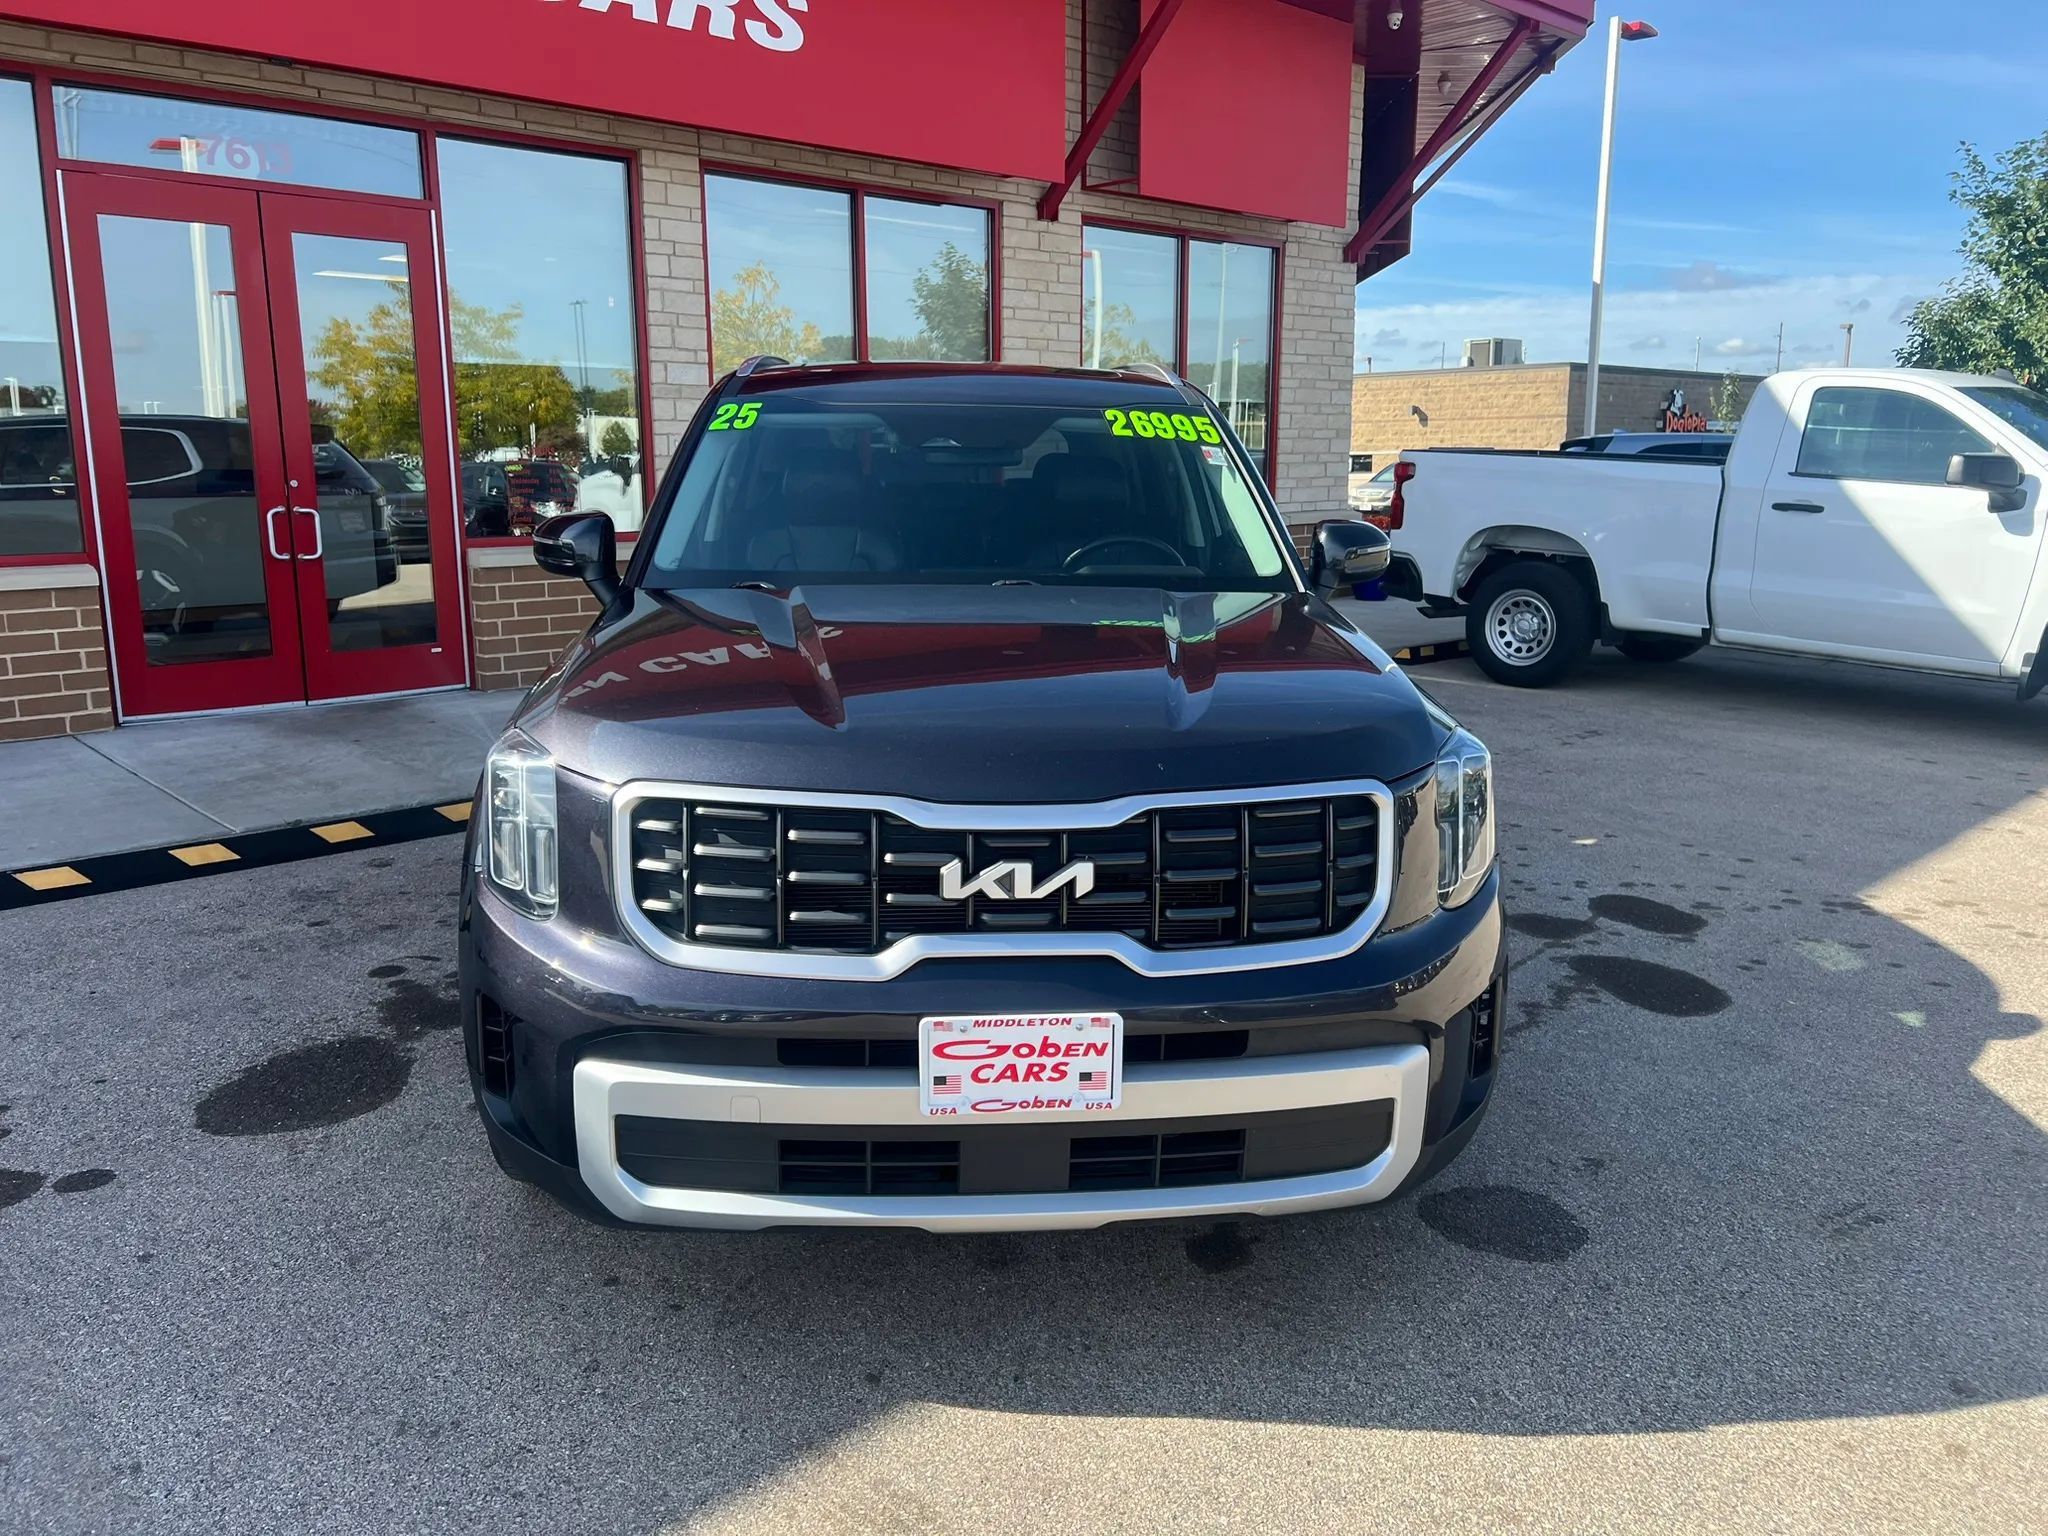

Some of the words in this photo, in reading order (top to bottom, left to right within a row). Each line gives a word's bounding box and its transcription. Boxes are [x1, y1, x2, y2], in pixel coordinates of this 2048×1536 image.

[707, 402, 763, 431] 25
[1104, 409, 1221, 444] 26995
[973, 1017, 1073, 1028] MIDDLETON
[970, 1062, 1070, 1084] CARS
[930, 1106, 958, 1116] USA
[1085, 1101, 1113, 1110] USA
